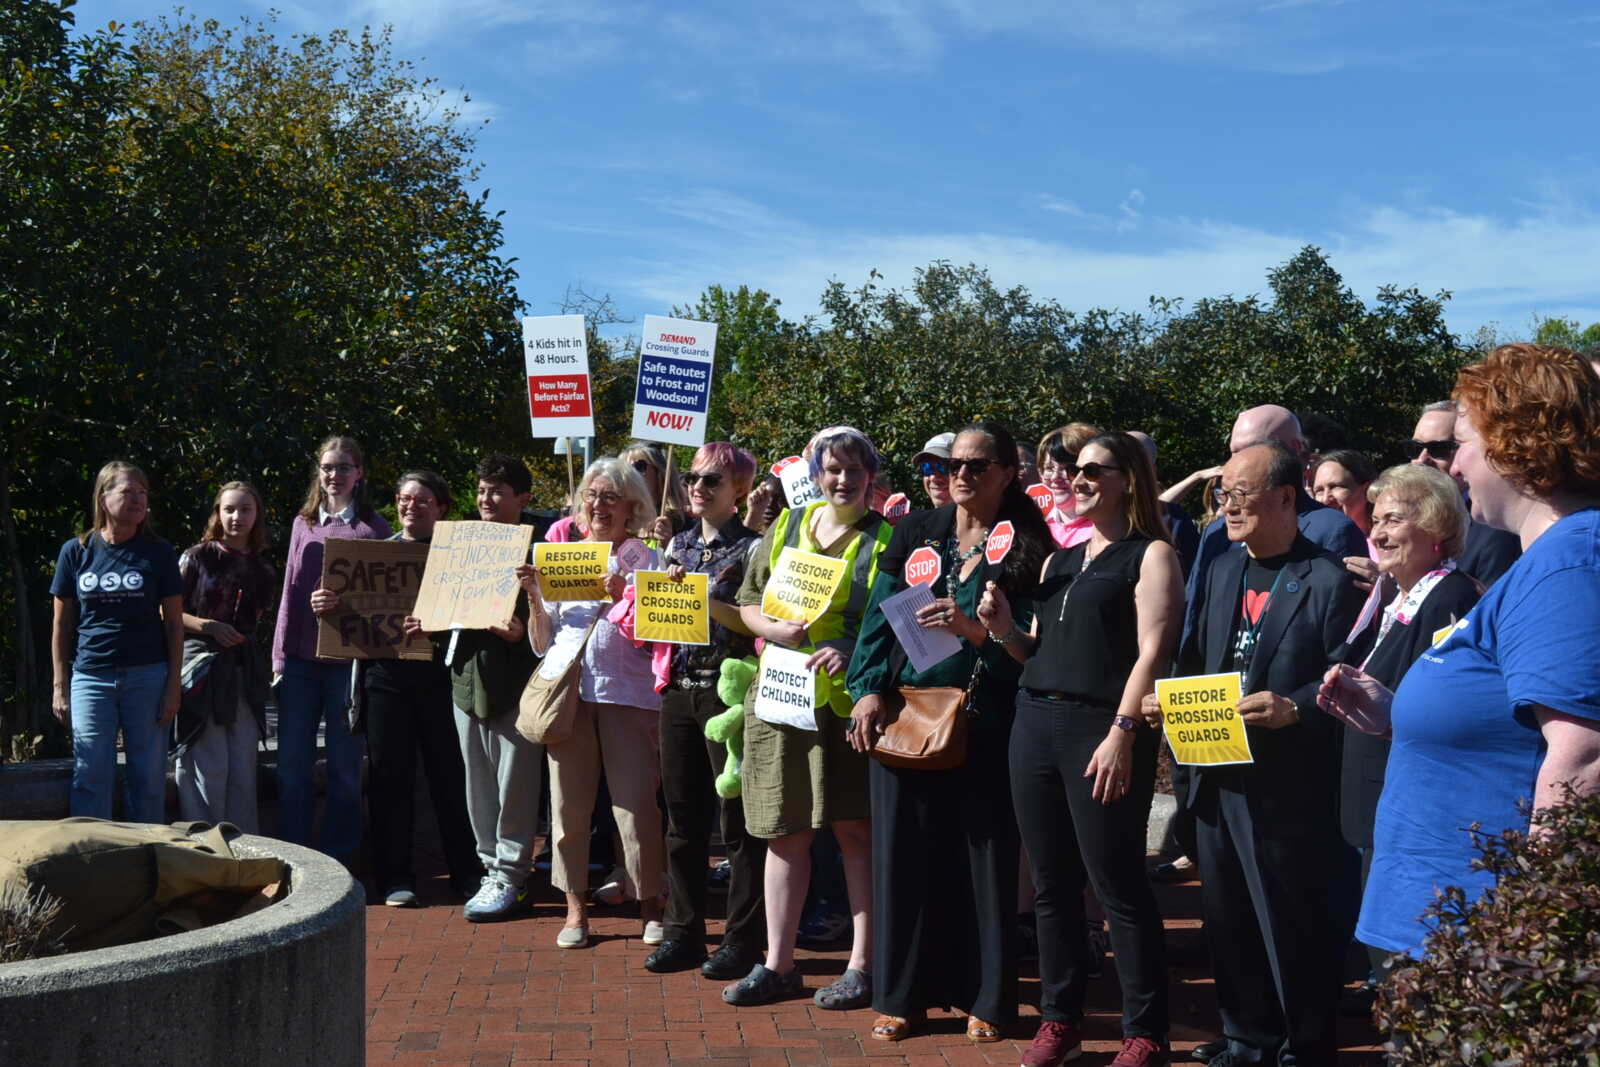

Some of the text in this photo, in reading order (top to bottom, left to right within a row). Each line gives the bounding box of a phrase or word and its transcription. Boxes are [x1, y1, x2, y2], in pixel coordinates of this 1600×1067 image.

[528, 337, 582, 349] 4 Kids hit in
[660, 333, 696, 345] DEMAND
[645, 341, 709, 357] Crossing Guards
[534, 354, 579, 364] 48 Hours.
[643, 361, 706, 379] Safe Routes
[539, 381, 578, 391] How Many
[641, 376, 705, 393] to Frost and
[534, 391, 585, 401] Before Fairfax
[645, 388, 698, 405] Woodson!
[551, 404, 570, 413] Acts?
[646, 410, 693, 432] NOW!
[1032, 494, 1052, 509] OP
[886, 502, 907, 518] STOP
[988, 533, 1011, 549] STOP
[545, 551, 597, 562] RESTORE
[540, 564, 602, 576] CROSSING
[788, 560, 834, 581] RESTORE
[908, 560, 936, 579] STOP
[550, 579, 597, 588] GUARDS
[647, 581, 696, 595] RESTORE
[641, 596, 702, 610] CROSSING
[777, 590, 821, 610] GUARDS
[648, 612, 694, 625] GUARDS
[765, 668, 807, 689] PROTECT
[761, 685, 811, 709] CHILDREN
[1169, 688, 1227, 706] RESTORE
[1166, 707, 1235, 725] CROSSING
[1177, 727, 1231, 743] GUARDS
